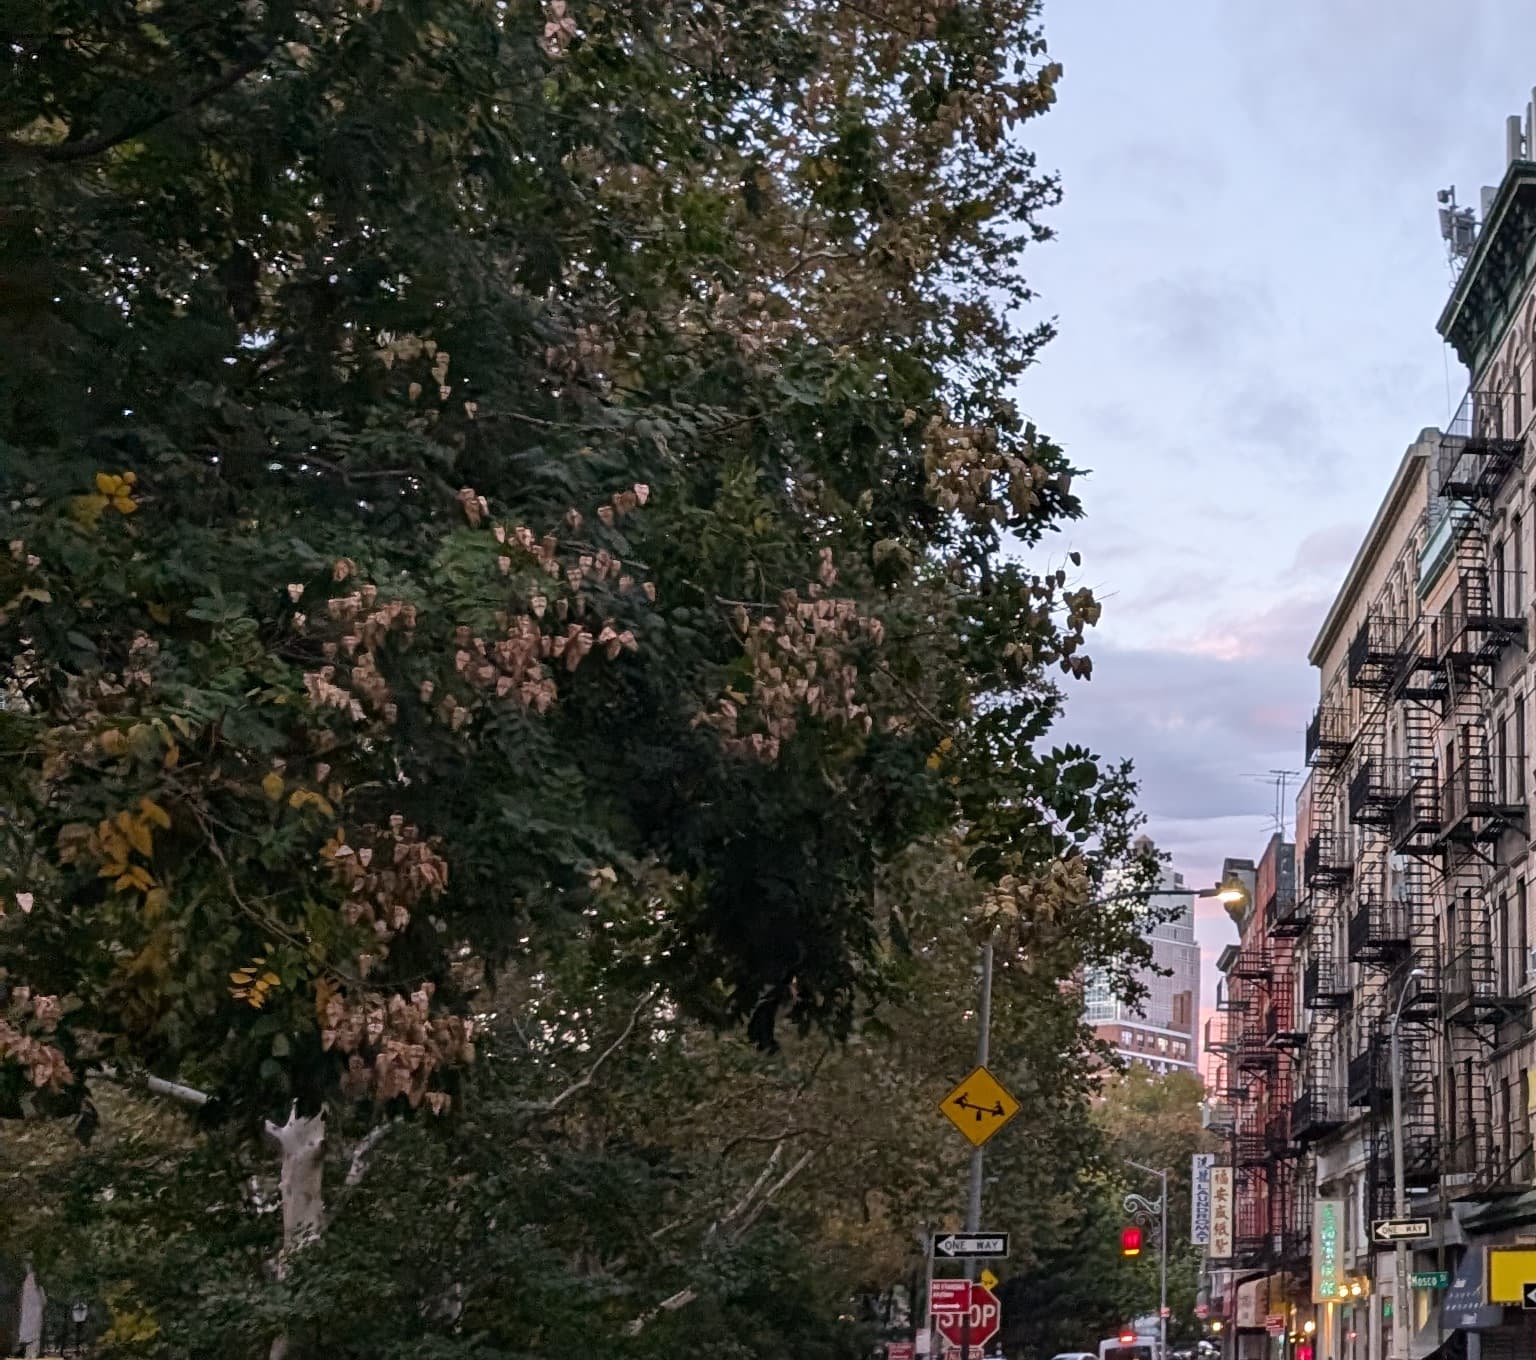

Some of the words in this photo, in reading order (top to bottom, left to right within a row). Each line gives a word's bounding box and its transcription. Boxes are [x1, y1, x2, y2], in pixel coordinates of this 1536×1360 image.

[1405, 1225, 1424, 1233] WAY
[944, 1240, 967, 1251] ONE
[976, 1240, 999, 1251] WAY
